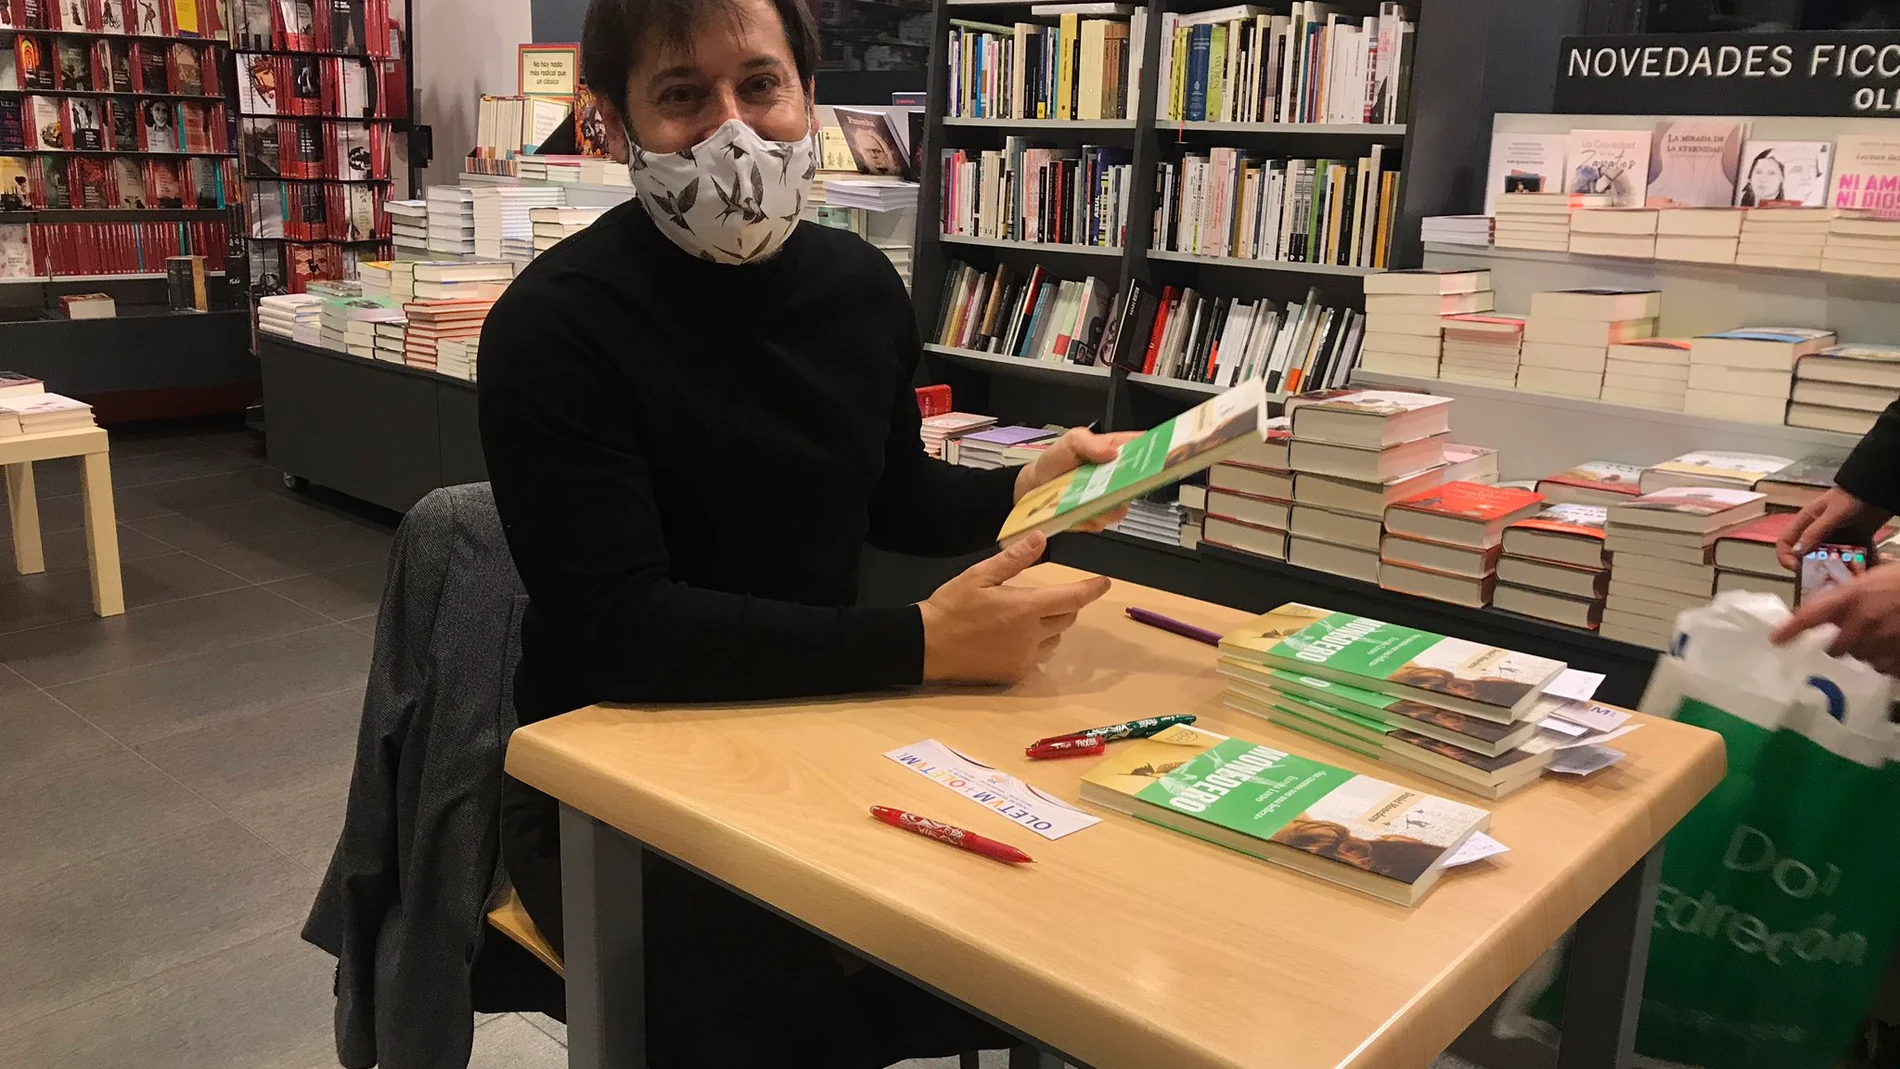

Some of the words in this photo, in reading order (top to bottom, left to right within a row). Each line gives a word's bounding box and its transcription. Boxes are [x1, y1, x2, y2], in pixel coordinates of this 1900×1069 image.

[1567, 45, 1793, 78] NOVEDADES
[1581, 140, 1593, 148] La
[1595, 140, 1636, 149] Gravedad
[1576, 149, 1637, 170] Zapatos
[1839, 173, 1860, 191] NI
[1864, 174, 1900, 192] AM
[1093, 195, 1101, 218] AZUL
[1835, 190, 1857, 208] NI
[1295, 616, 1387, 663] MONEDERO
[1169, 744, 1290, 813] MONEDERO
